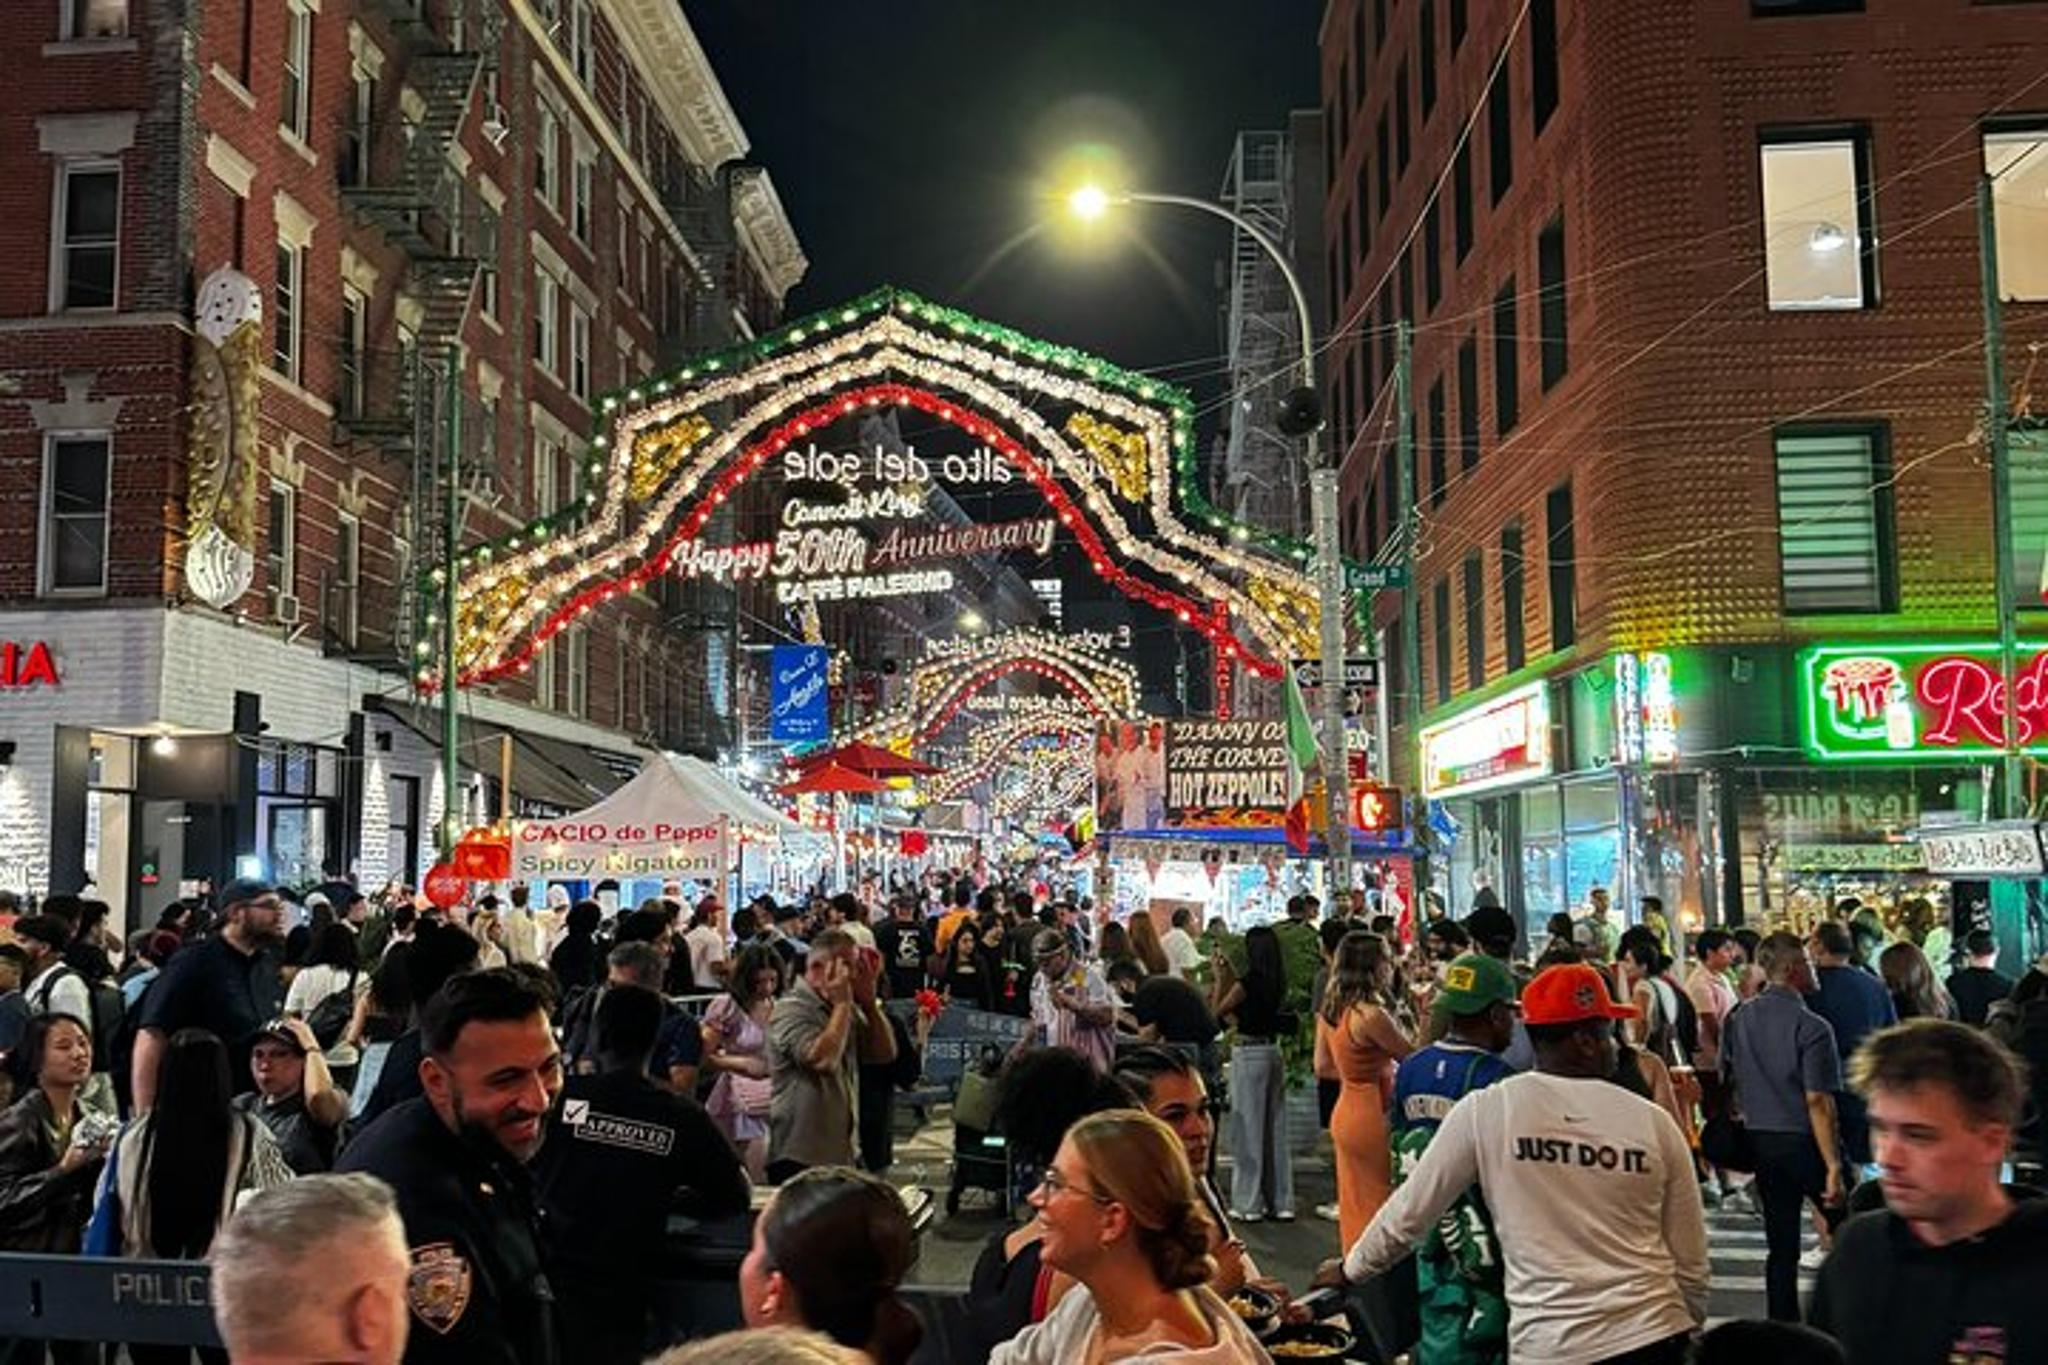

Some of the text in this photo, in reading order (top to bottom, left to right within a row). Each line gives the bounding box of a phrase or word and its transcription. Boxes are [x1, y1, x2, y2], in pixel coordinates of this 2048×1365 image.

[671, 518, 1055, 581] Happy 50th Anniversary
[848, 570, 953, 597] PALERMO
[1349, 568, 1385, 586] Grand
[1172, 721, 1260, 745] DANNY
[1170, 745, 1287, 768] THE CORNE
[1170, 773, 1204, 808] HOT
[521, 824, 718, 844] CACIO de Pepe
[521, 855, 596, 874] Spicy
[1516, 1137, 1651, 1174] JUST DO IT.
[113, 1272, 206, 1306] POLIC
